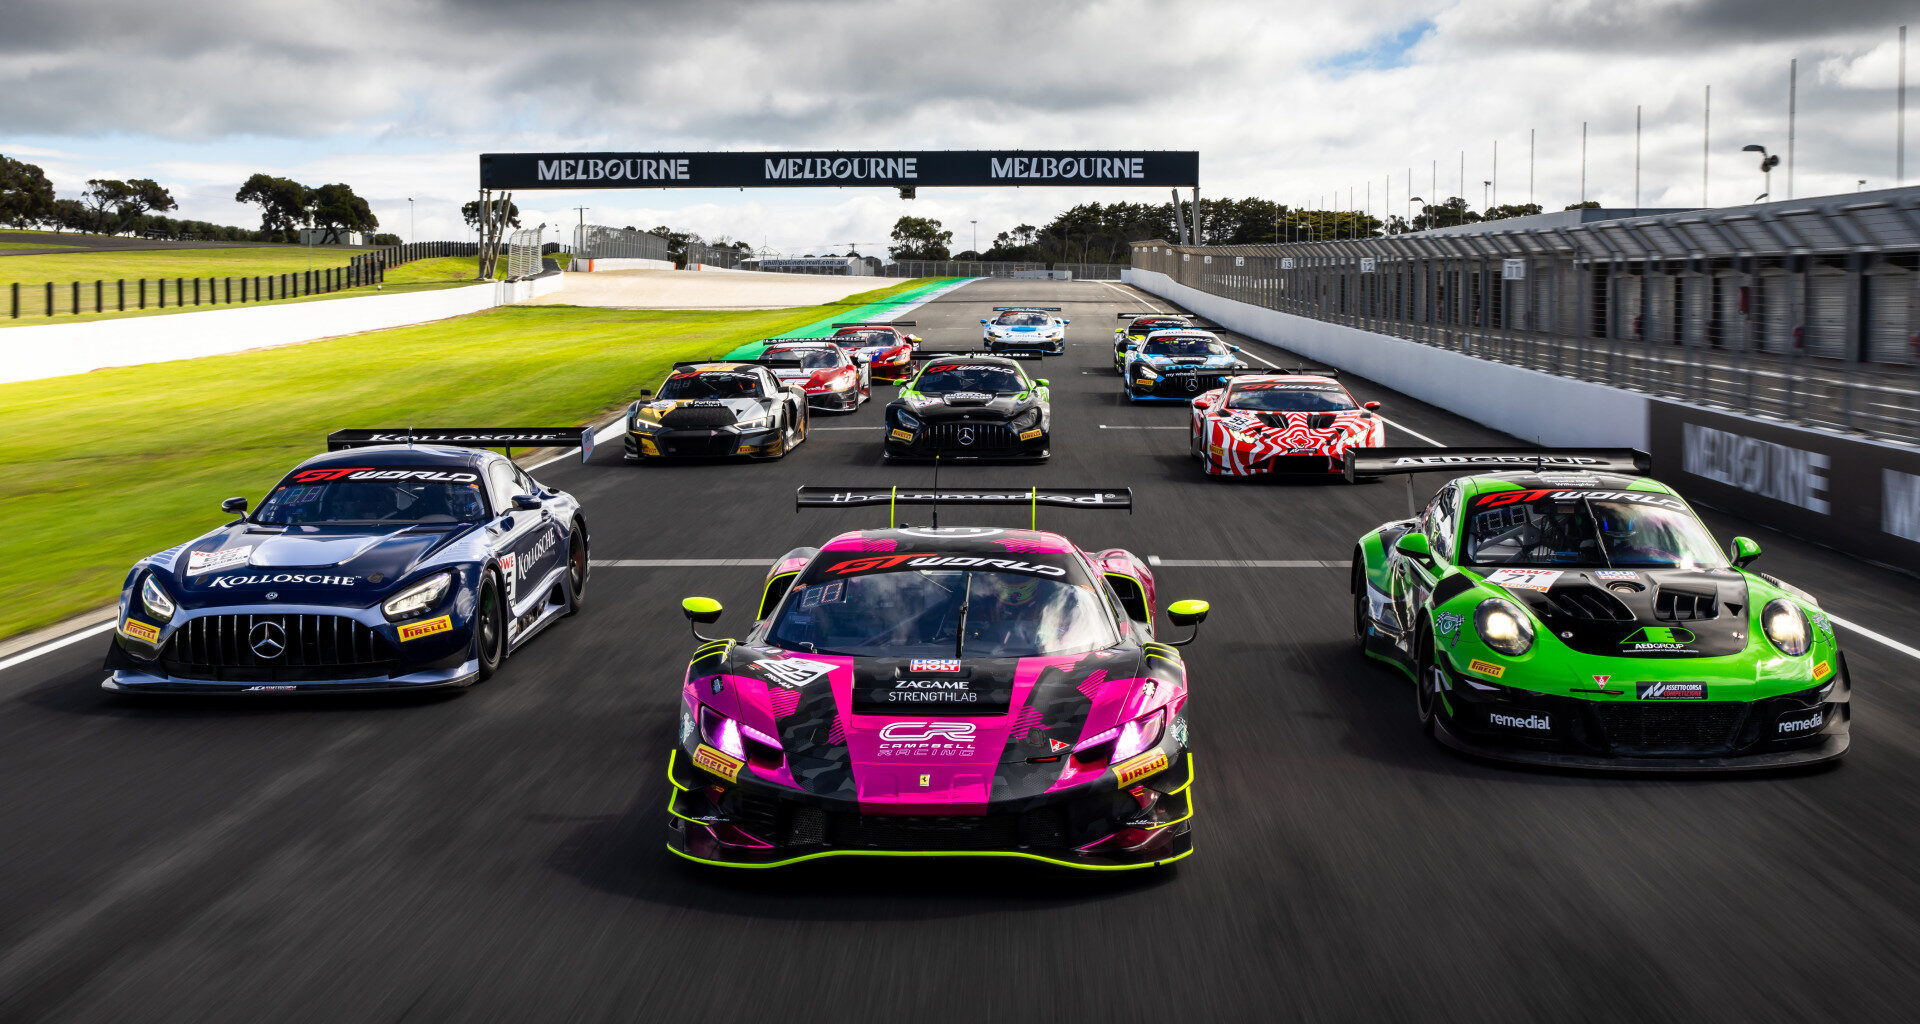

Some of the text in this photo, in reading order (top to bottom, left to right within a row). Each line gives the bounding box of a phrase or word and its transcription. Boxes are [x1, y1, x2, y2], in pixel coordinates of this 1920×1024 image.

[538, 159, 690, 181] MELBOURNE
[765, 158, 918, 179] MELBOURNE
[991, 157, 1145, 179] MELBOURNE
[1021, 430, 1042, 441] PIRELLI
[518, 526, 556, 581] KOLLOSCHE
[208, 573, 355, 589] KOLLOSCHE
[1502, 573, 1536, 584] 71
[125, 621, 157, 641] PIRELLI
[402, 618, 448, 639] PIRELLI
[1471, 660, 1502, 676] PIRELLI
[1813, 662, 1829, 678] PIRELLI
[895, 680, 970, 690] ZAGAME
[888, 691, 978, 702] STRENGTHLAB
[1490, 713, 1551, 730] remedial
[877, 749, 975, 757] RACING
[694, 748, 738, 779] PIRELLI
[1119, 753, 1166, 783] PIRELLI
